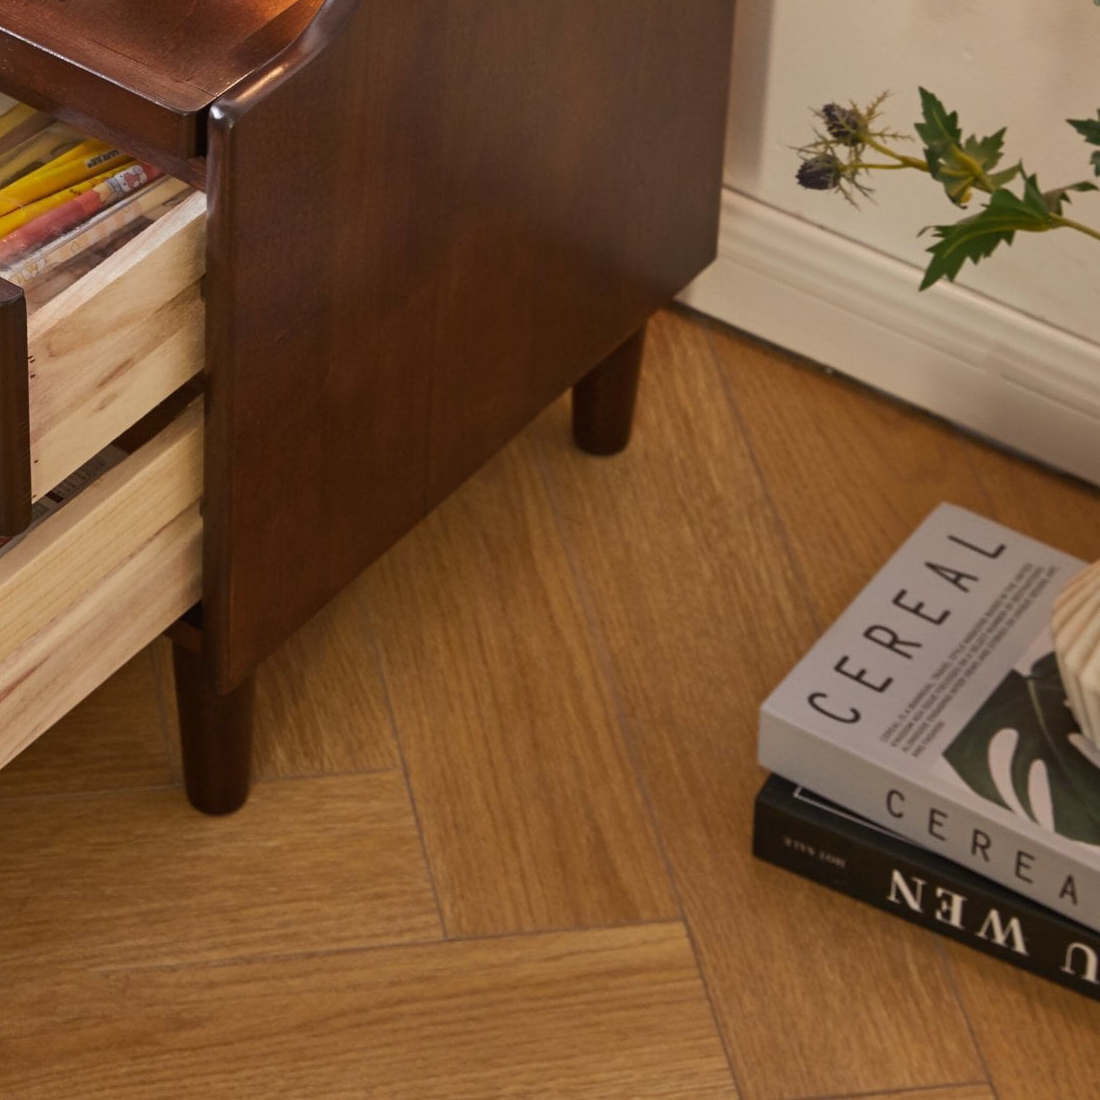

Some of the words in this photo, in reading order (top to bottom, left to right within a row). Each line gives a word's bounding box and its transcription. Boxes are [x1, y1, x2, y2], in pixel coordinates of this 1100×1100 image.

[807, 534, 1007, 725] CEREAL
[885, 789, 1078, 906] CEREA
[886, 868, 1029, 957] WEN
